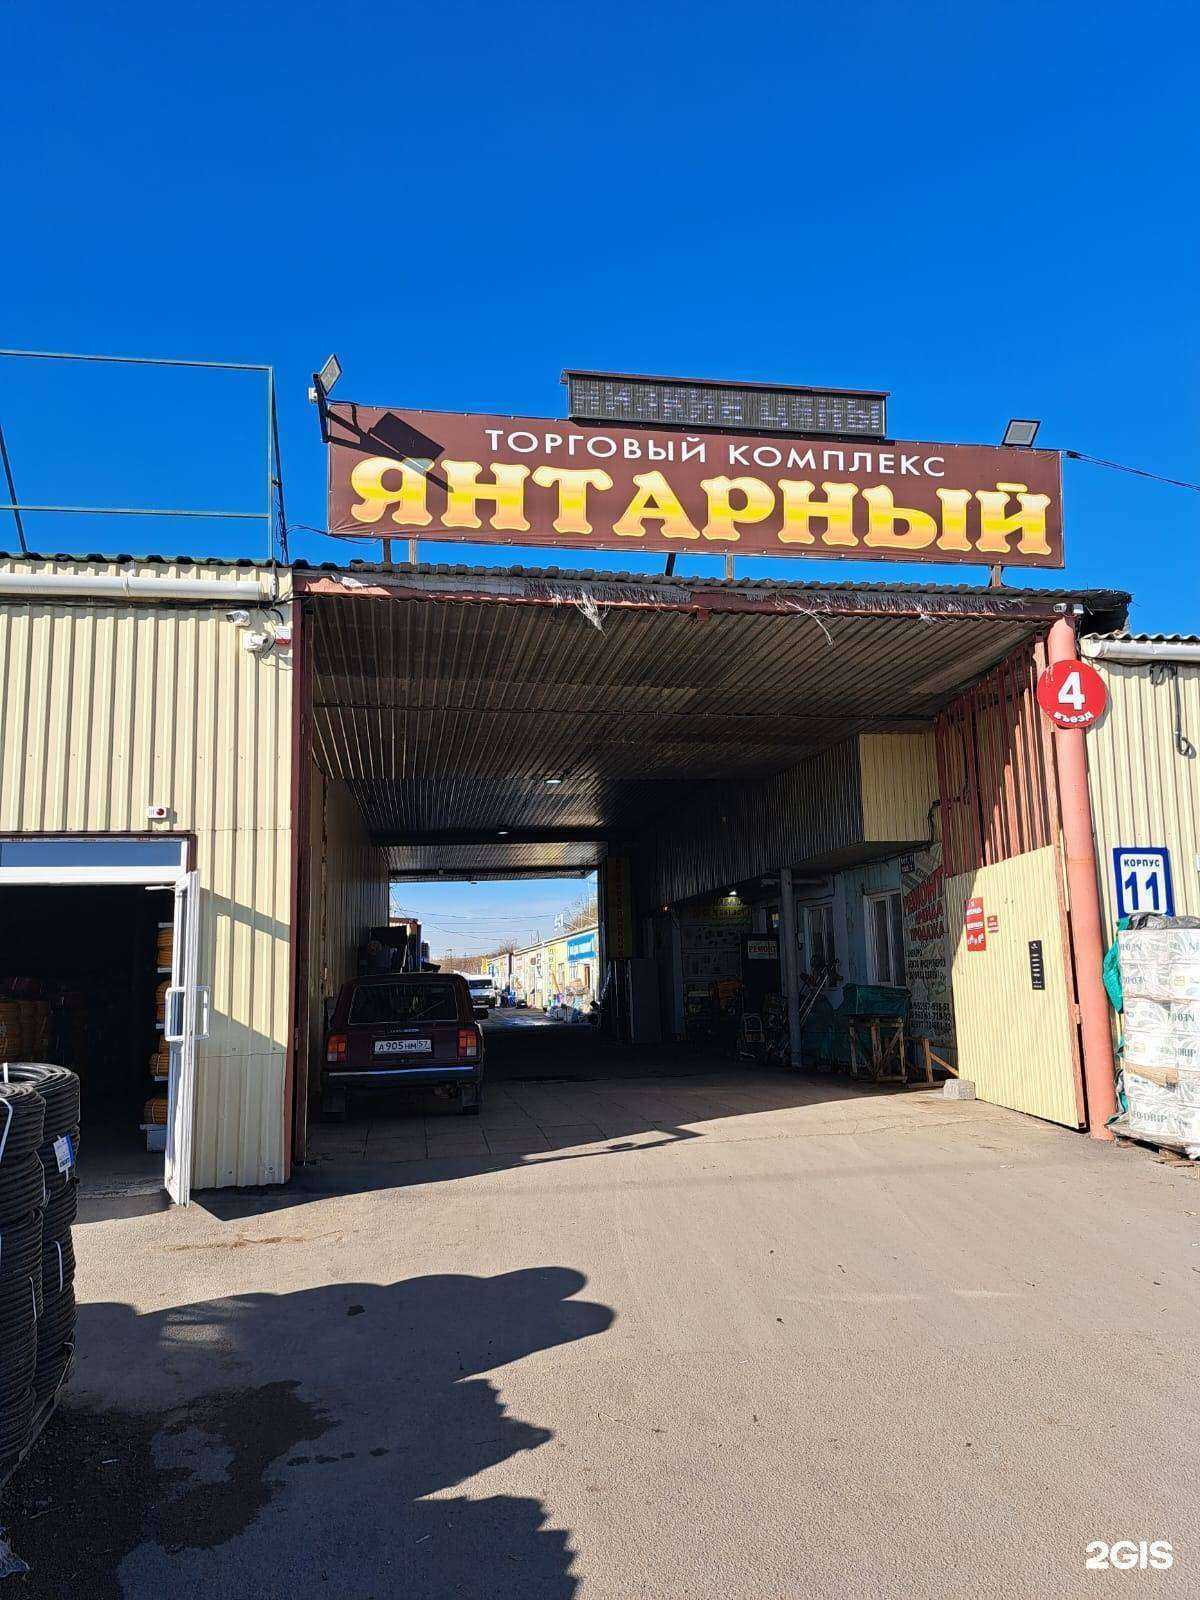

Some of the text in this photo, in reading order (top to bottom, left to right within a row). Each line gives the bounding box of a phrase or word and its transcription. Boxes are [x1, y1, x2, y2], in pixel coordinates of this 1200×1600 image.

[485, 427, 946, 478] ТОРГОВЫЙ КОМПЛЕКС
[349, 455, 1053, 556] ЯНТАРНЫЙ
[1057, 671, 1086, 711] 4
[1124, 858, 1160, 868] КОРПУС
[1125, 871, 1160, 911] 11
